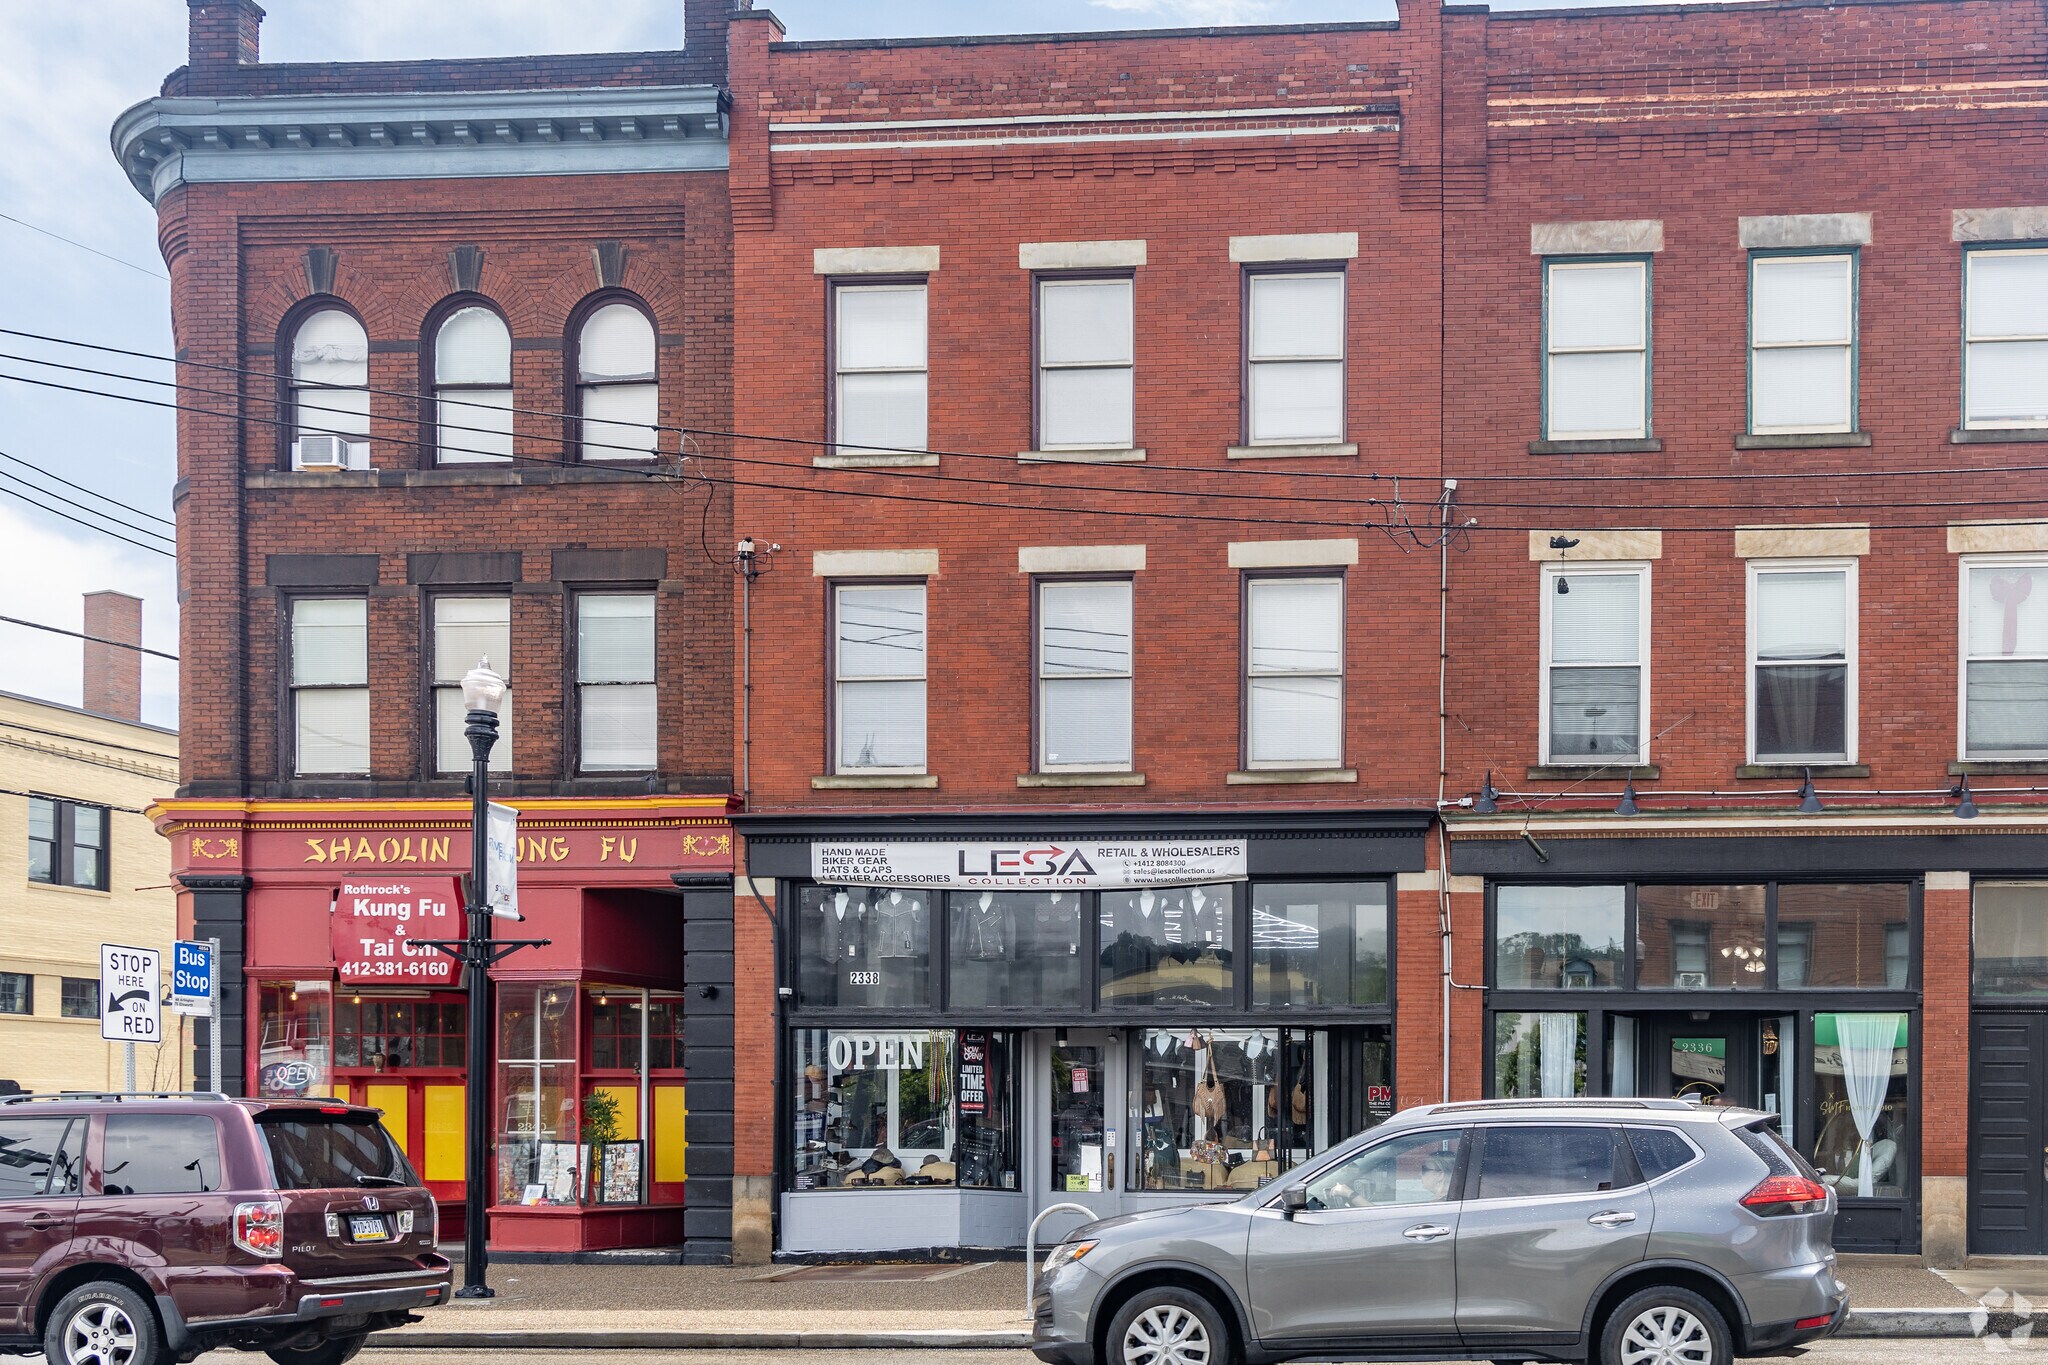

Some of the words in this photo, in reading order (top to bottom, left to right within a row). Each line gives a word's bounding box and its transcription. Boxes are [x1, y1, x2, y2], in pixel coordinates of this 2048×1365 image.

[303, 836, 450, 863] SHAOLIN
[516, 836, 570, 862] UNG
[600, 835, 638, 863] FU
[822, 848, 852, 856] HAND
[855, 848, 886, 856] MADE
[1097, 848, 1137, 857] RETAIL
[1140, 848, 1148, 857] &
[1152, 846, 1240, 857] WHOLESALERS
[822, 857, 854, 865] BIKER
[857, 857, 888, 865] GEAR
[959, 846, 1097, 876] LESA
[968, 877, 1086, 885] COLLECTION
[344, 884, 411, 894] Rothrock's
[1695, 892, 1716, 908] EXIT
[353, 899, 411, 920] Kung
[419, 899, 446, 916] Fu
[395, 924, 406, 936] &
[360, 939, 394, 956] Tai
[110, 953, 152, 973] STOP
[180, 947, 206, 967] Bus
[341, 962, 449, 976] 412-381-6160
[118, 975, 144, 988] HERE
[176, 970, 209, 993] Stop
[851, 972, 879, 984] 2338
[132, 1002, 146, 1013] ON
[124, 1015, 154, 1034] RED
[829, 1035, 923, 1070] OPEN
[1682, 1043, 1712, 1052] 2336
[277, 1066, 317, 1081] OPEN
[962, 1065, 983, 1074] LIMITED
[960, 1074, 985, 1090] TIME
[961, 1090, 984, 1102] OFFER
[292, 1245, 317, 1253] PILOT
